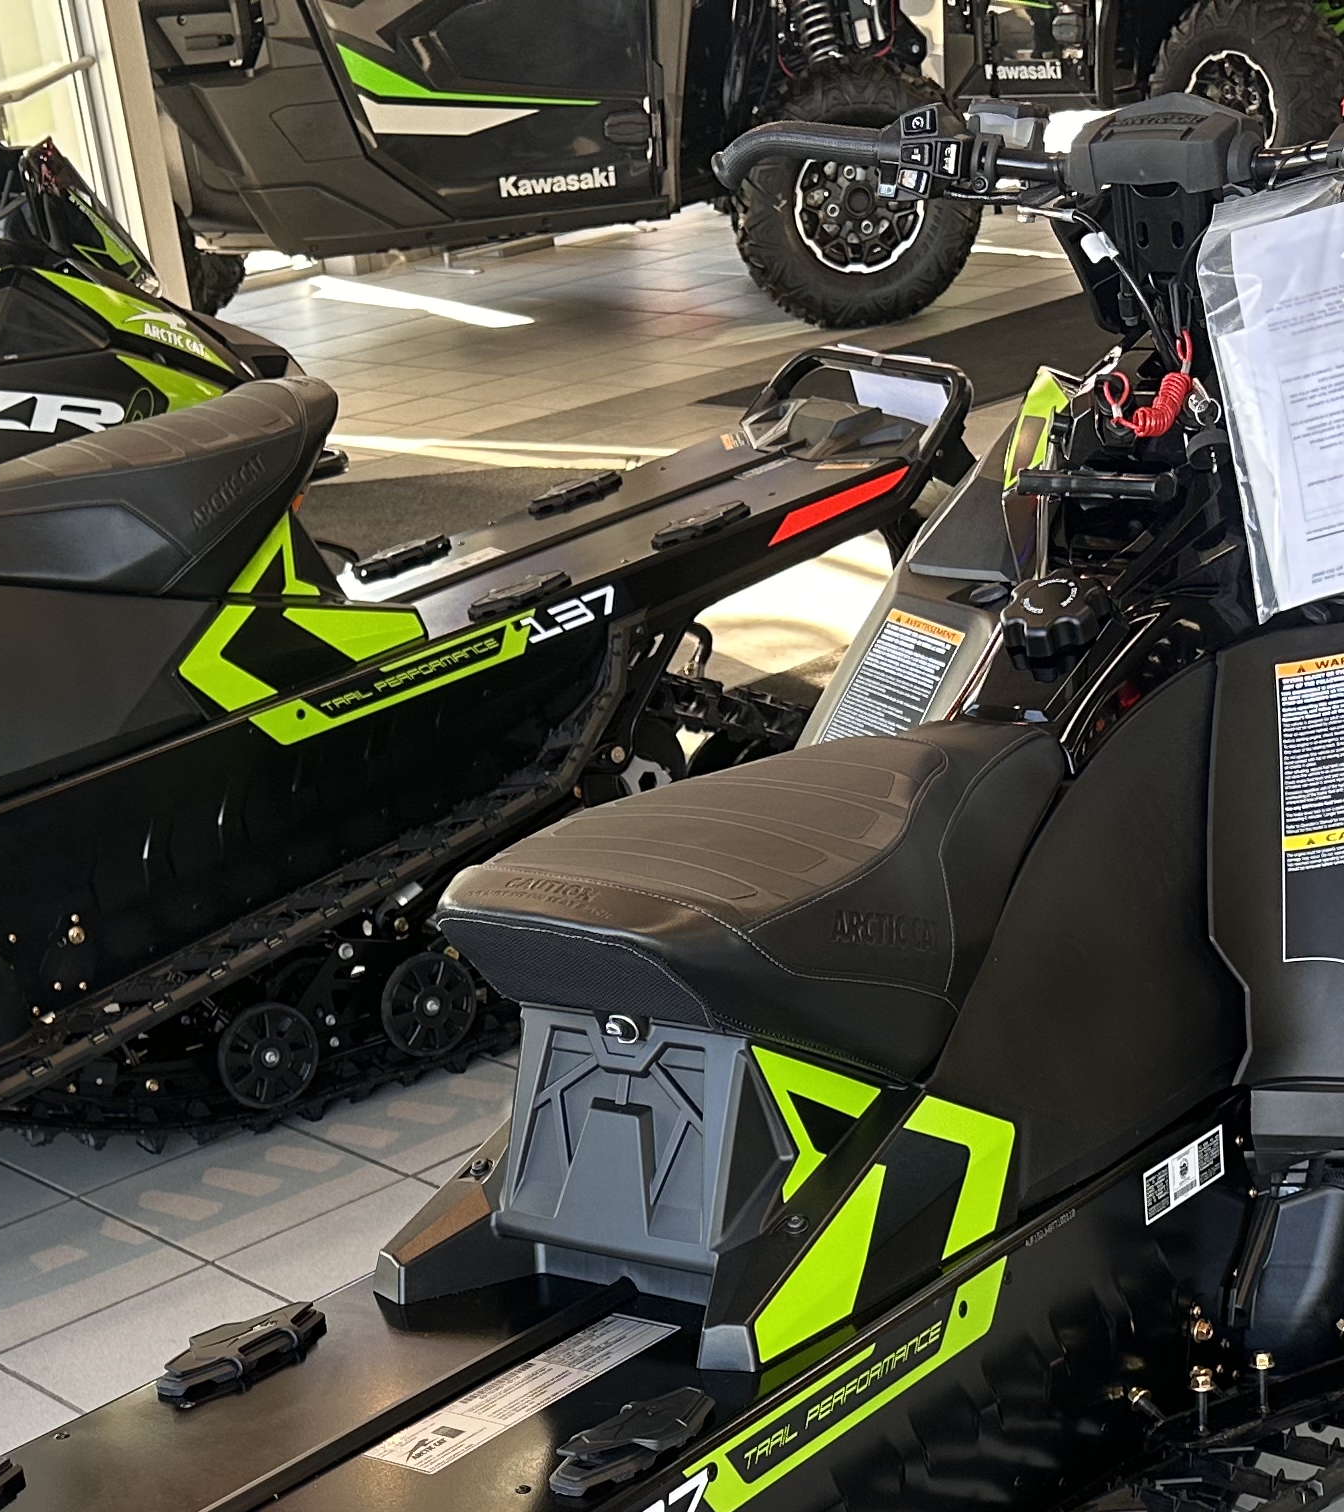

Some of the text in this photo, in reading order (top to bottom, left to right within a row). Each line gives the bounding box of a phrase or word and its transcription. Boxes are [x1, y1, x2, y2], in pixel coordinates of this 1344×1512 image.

[500, 166, 616, 199] Kawasaki
[144, 321, 206, 356] ARCTIC CAT
[520, 584, 615, 644] 137
[905, 613, 956, 641] AVERTISSEMENT
[320, 637, 500, 712] TRAIL PERFORMANCE
[505, 876, 600, 902] CAUTION
[832, 910, 908, 949] ARCTIC
[744, 1320, 943, 1471] TRAIL PERFORMANCE
